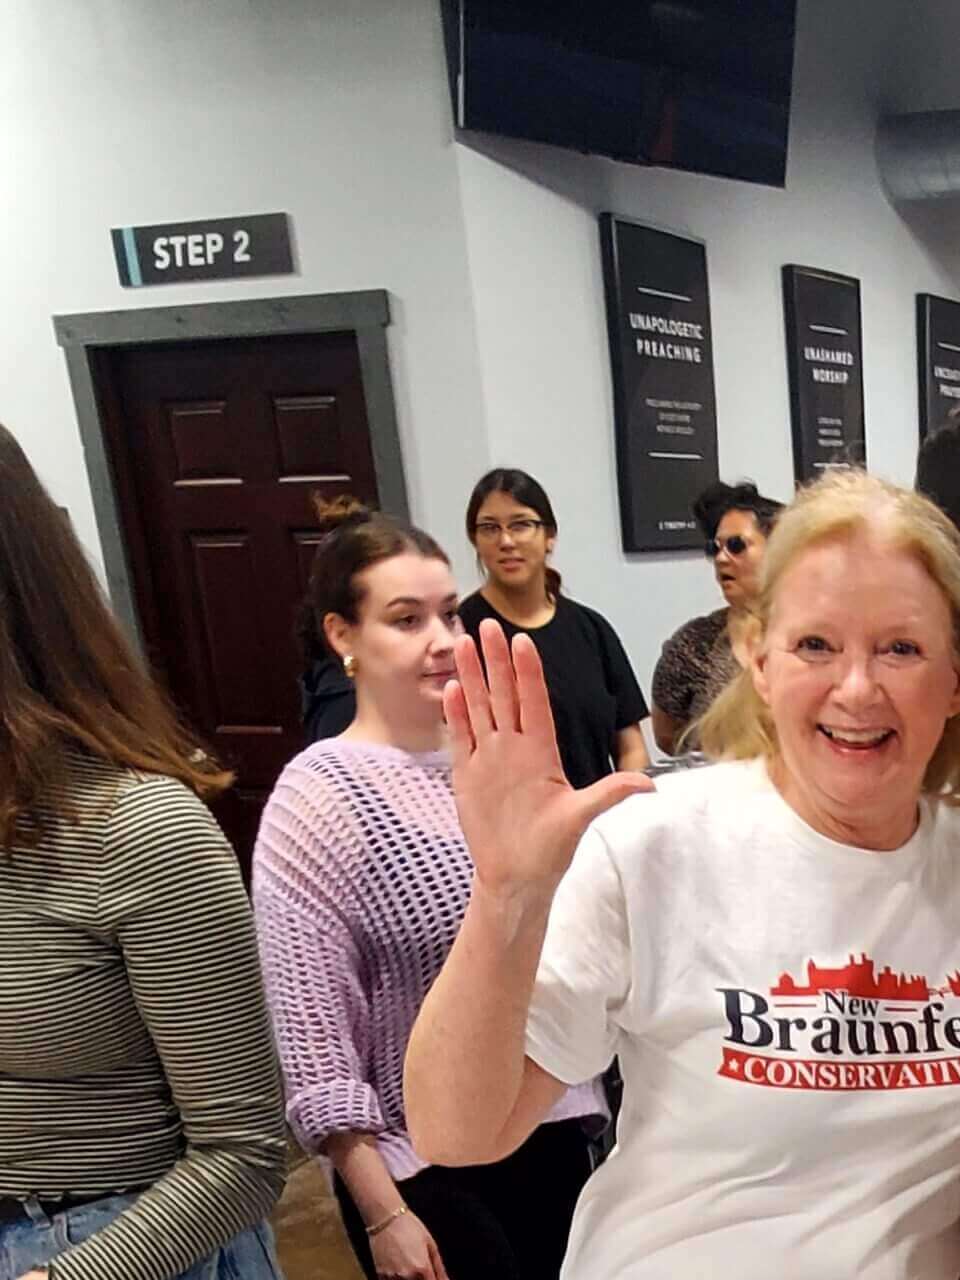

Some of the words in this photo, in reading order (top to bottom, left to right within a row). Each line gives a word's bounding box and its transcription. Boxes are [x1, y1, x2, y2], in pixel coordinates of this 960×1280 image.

[153, 232, 224, 268] STEP
[233, 230, 251, 263] 2
[629, 313, 704, 339] UNAPOLOGETIC
[636, 339, 702, 363] PREACHING
[804, 346, 854, 365] UNASHAMED
[813, 368, 849, 384] WORSHIP
[823, 991, 880, 1016] New
